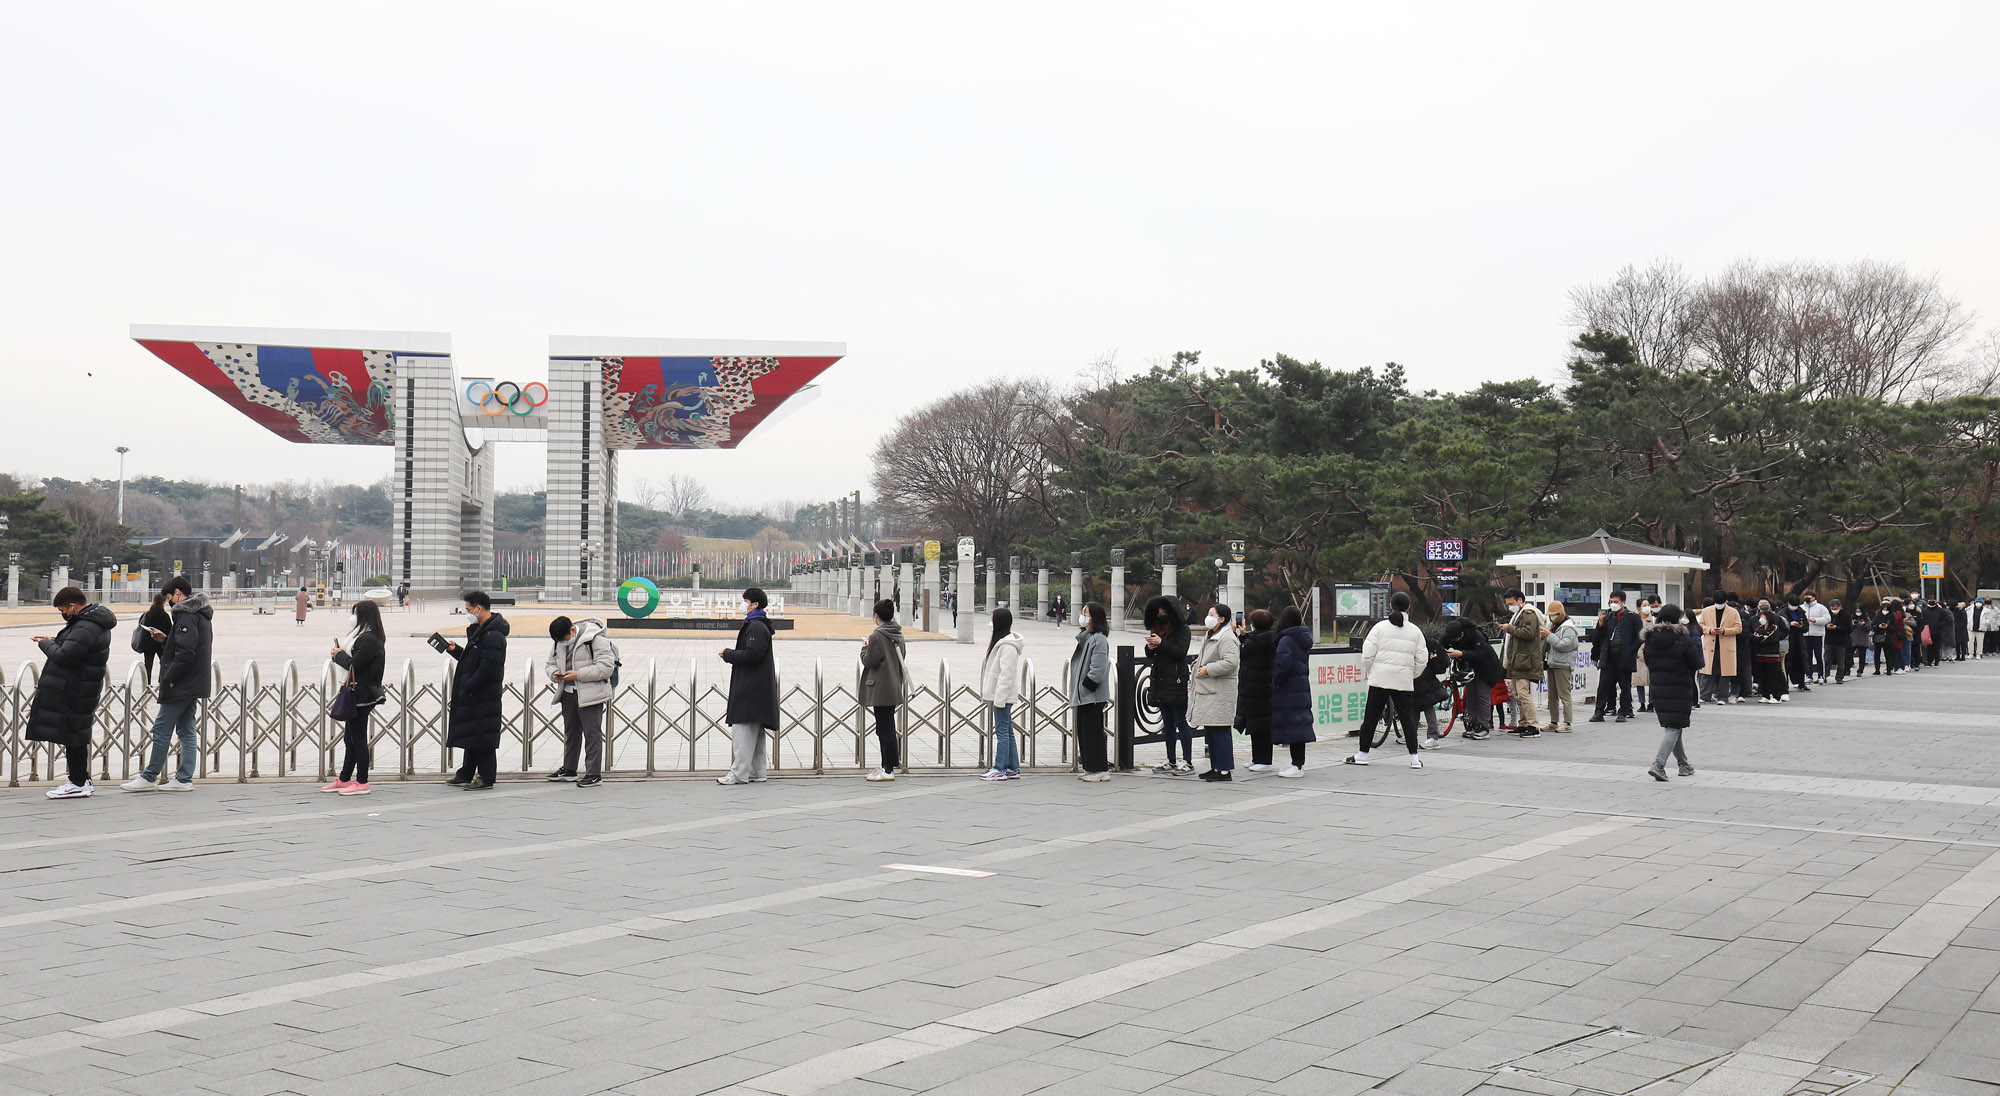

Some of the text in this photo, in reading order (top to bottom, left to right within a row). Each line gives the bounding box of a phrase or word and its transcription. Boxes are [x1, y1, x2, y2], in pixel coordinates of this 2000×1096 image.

[696, 622, 716, 630] OLYMPIC
[717, 622, 729, 630] PARK
[1318, 666, 1335, 685] 매주
[1337, 665, 1361, 684] 하루는
[1318, 694, 1342, 725] 맑은
